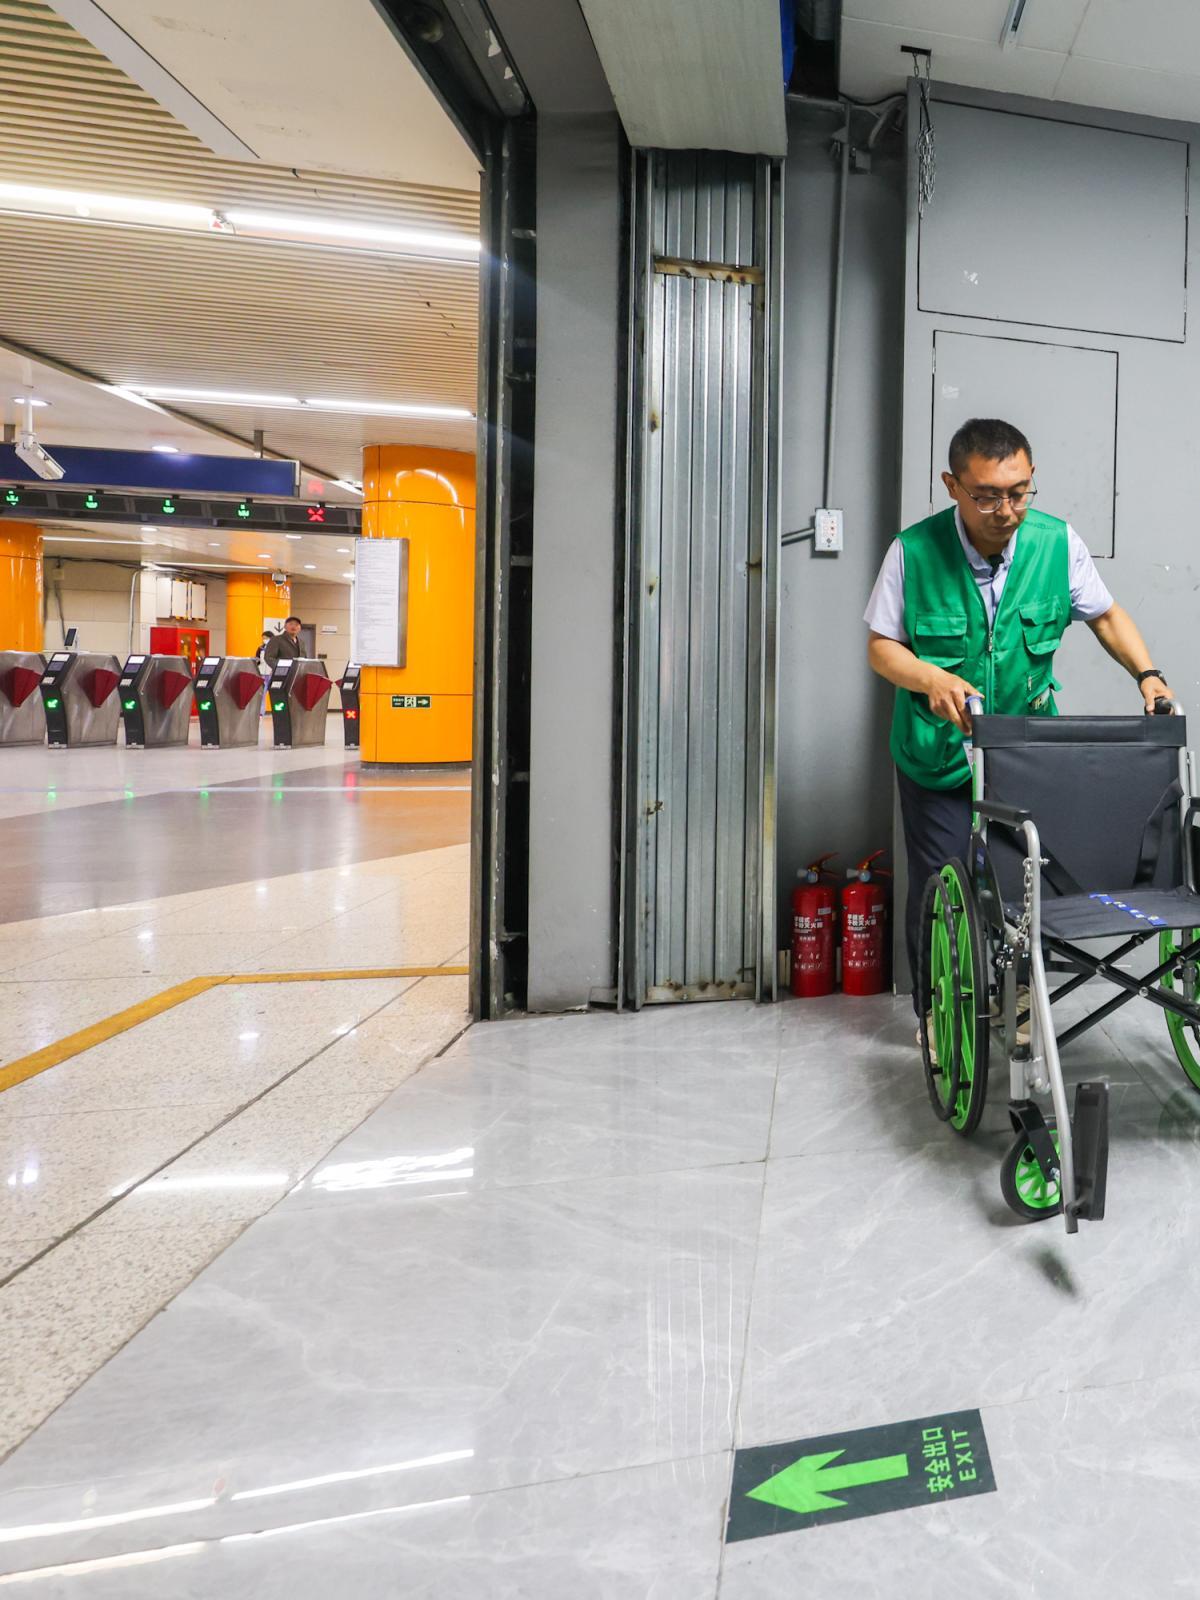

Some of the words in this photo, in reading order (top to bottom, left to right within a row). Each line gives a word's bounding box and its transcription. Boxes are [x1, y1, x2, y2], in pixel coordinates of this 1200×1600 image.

[922, 1427, 954, 1493] 安全出口
[951, 1430, 977, 1481] EXIT
